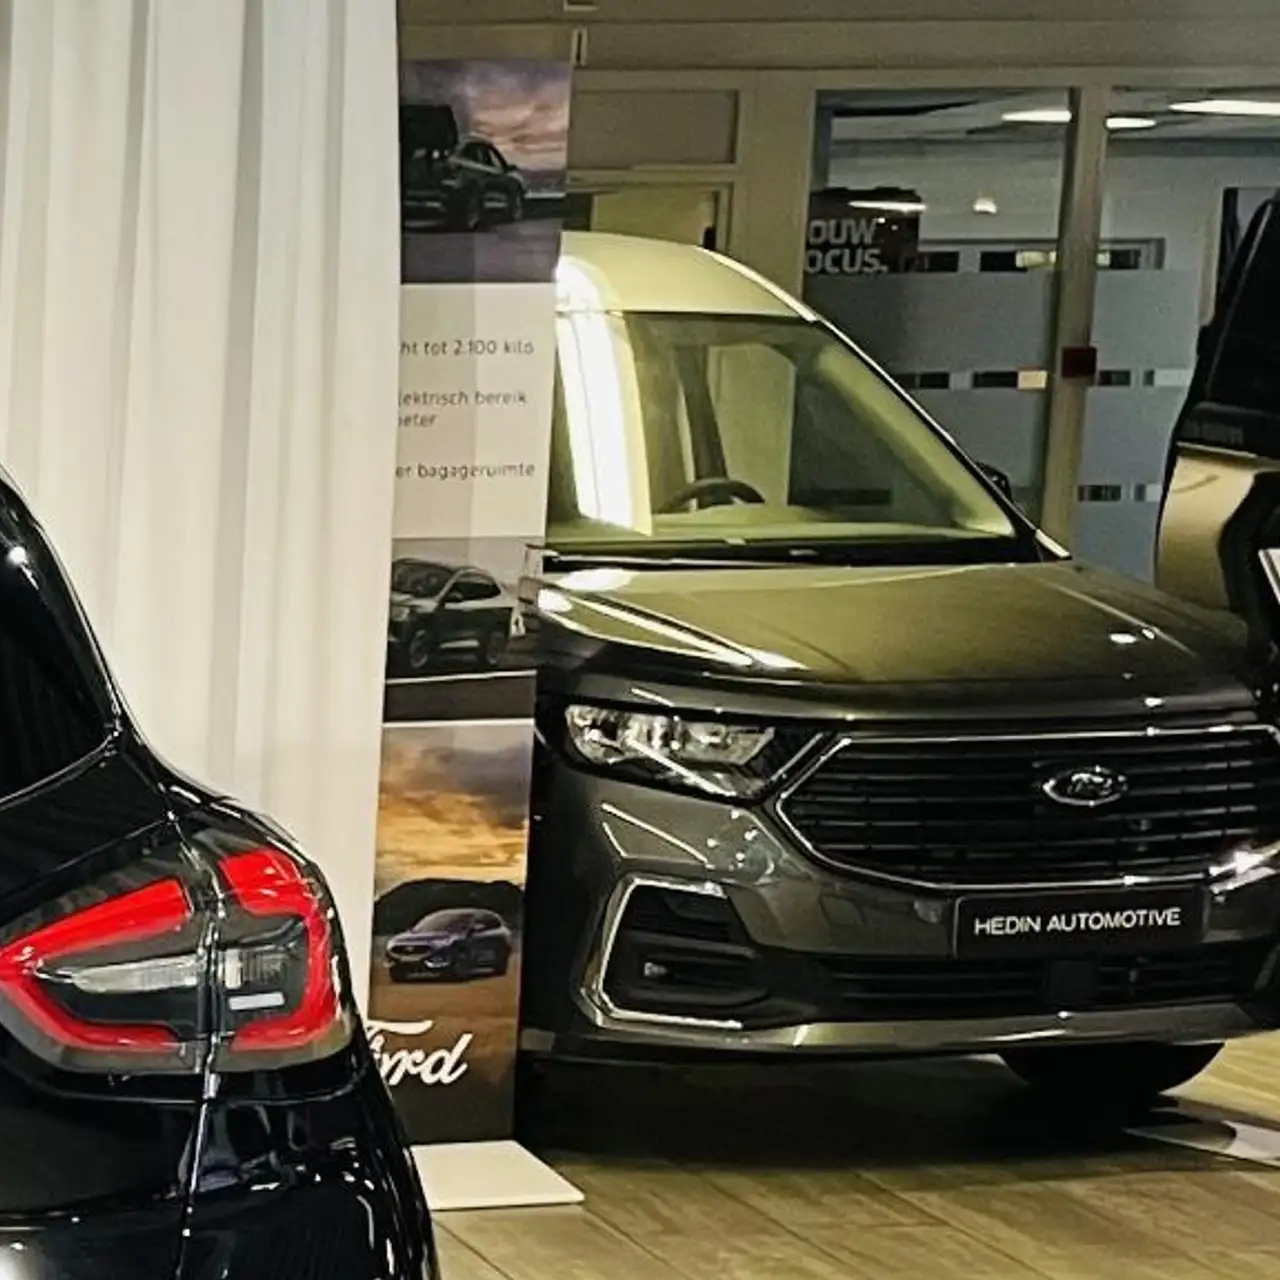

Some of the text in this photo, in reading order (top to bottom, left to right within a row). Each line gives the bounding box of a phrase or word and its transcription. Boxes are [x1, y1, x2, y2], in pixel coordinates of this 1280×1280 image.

[424, 340, 448, 356] tot
[504, 339, 535, 355] kilo
[475, 390, 527, 406] bereik
[417, 462, 536, 481] bagageruimte
[974, 907, 1182, 936] HEDIN AUTOMOTIVE
